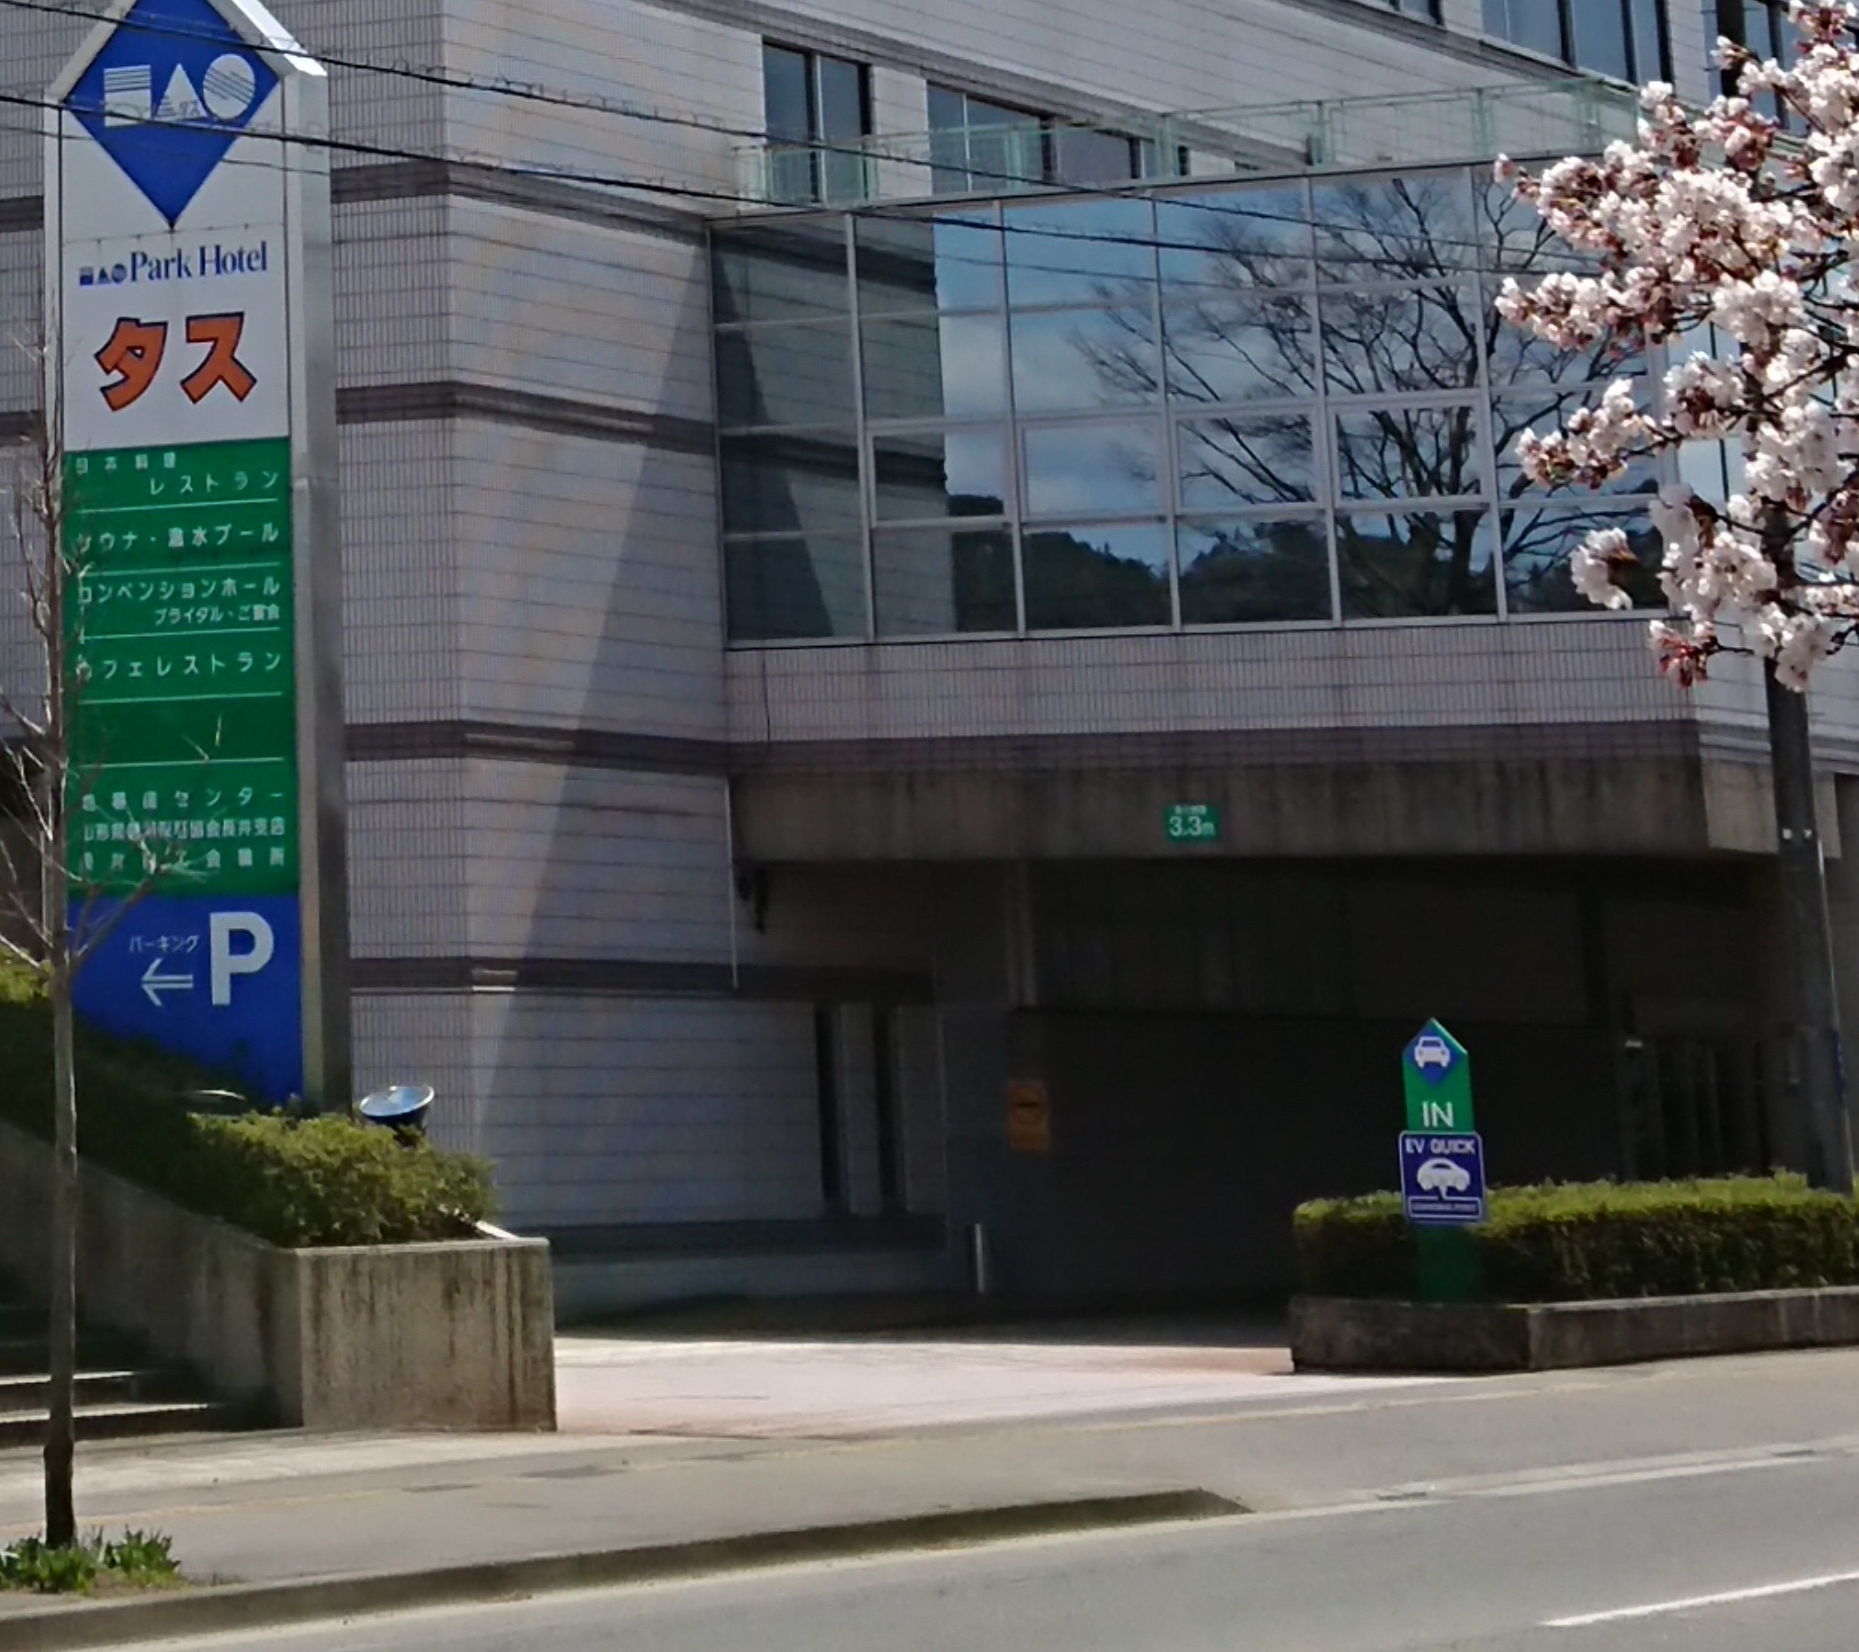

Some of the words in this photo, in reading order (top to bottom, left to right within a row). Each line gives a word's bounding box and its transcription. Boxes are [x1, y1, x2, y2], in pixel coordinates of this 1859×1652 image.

[130, 248, 192, 283] Park
[199, 240, 268, 277] Hotel
[93, 311, 258, 412] タス
[149, 470, 279, 496] レストラン
[80, 575, 281, 604] コンベンションホール
[1169, 815, 1215, 837] 3.3m
[128, 933, 200, 953] パーキング
[209, 910, 275, 1006] P
[1422, 1101, 1454, 1128] IN
[1405, 1138, 1425, 1154] EV
[1430, 1138, 1476, 1155] QUICK
